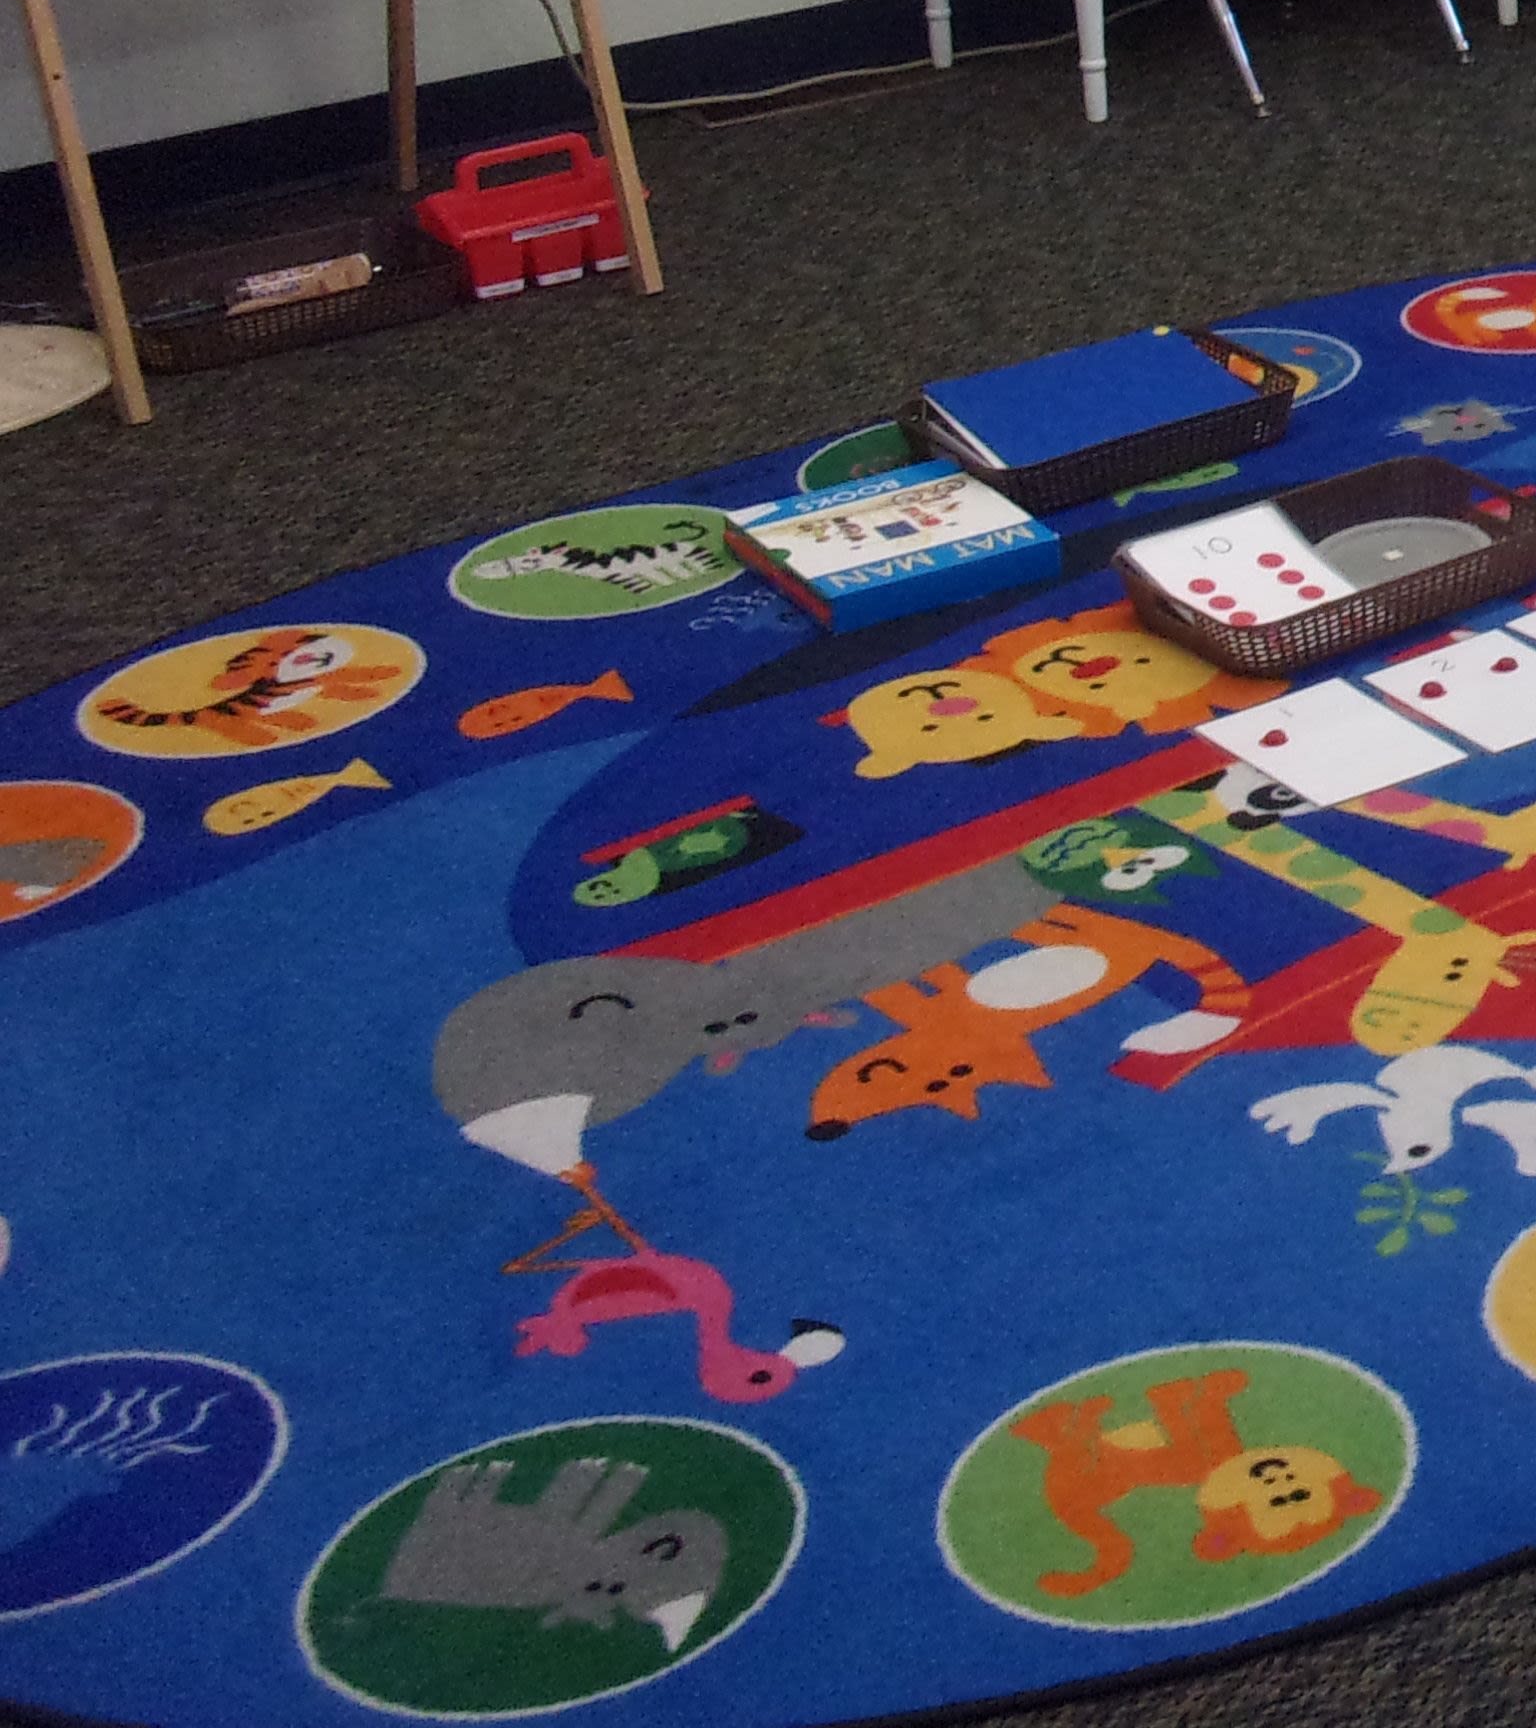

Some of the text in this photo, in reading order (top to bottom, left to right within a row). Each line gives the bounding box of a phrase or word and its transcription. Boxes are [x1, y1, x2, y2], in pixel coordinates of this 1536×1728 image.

[795, 478, 900, 513] BOOKS
[827, 525, 1036, 590] MAT MAN
